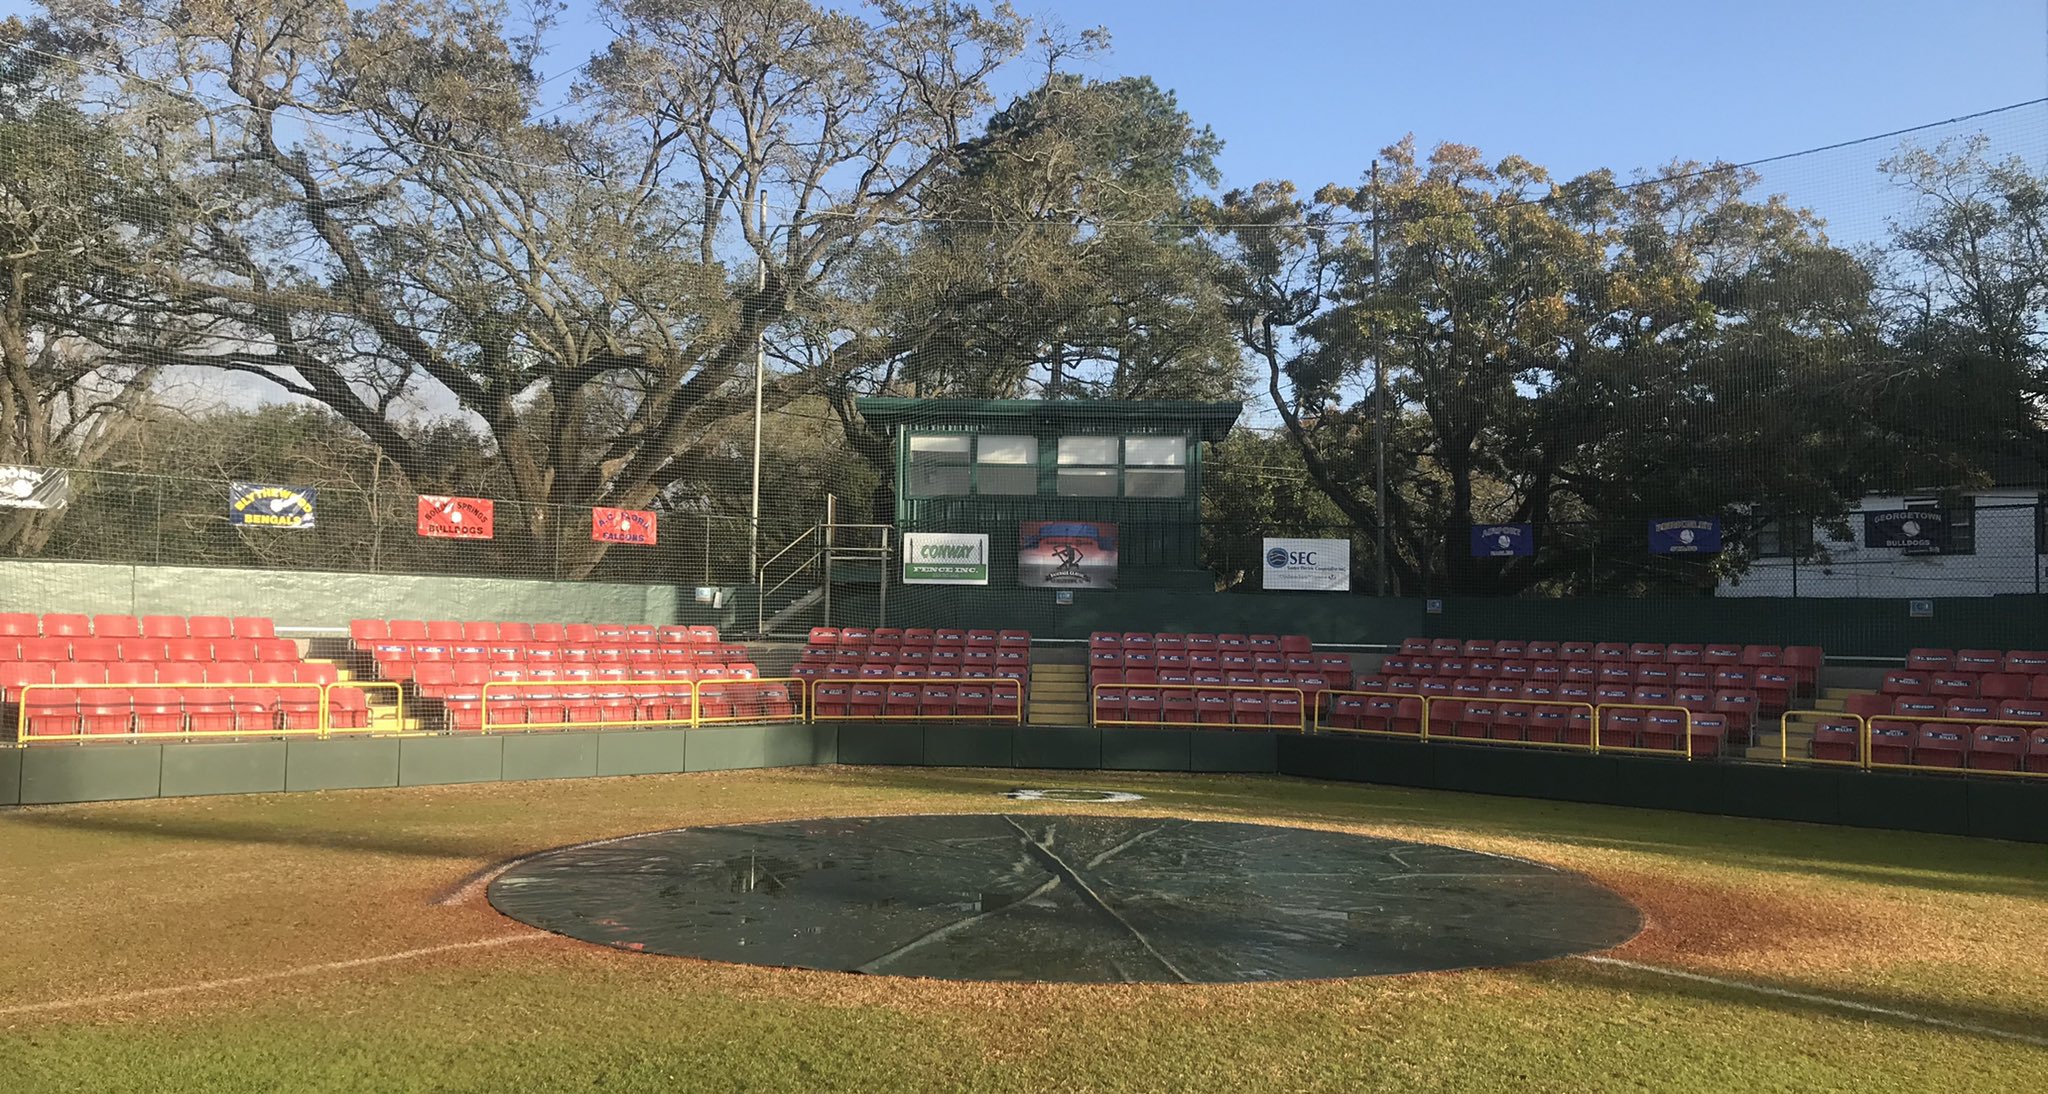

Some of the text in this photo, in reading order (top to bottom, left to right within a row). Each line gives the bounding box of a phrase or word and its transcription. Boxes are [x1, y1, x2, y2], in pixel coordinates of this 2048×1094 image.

[457, 501, 488, 523] SPRINGS
[1874, 511, 1941, 523] GEORGETOWN
[244, 513, 301, 525] BENGALS
[428, 524, 483, 535] BULLDOGS
[920, 544, 974, 559] CONWAY
[1289, 551, 1317, 565] SEC
